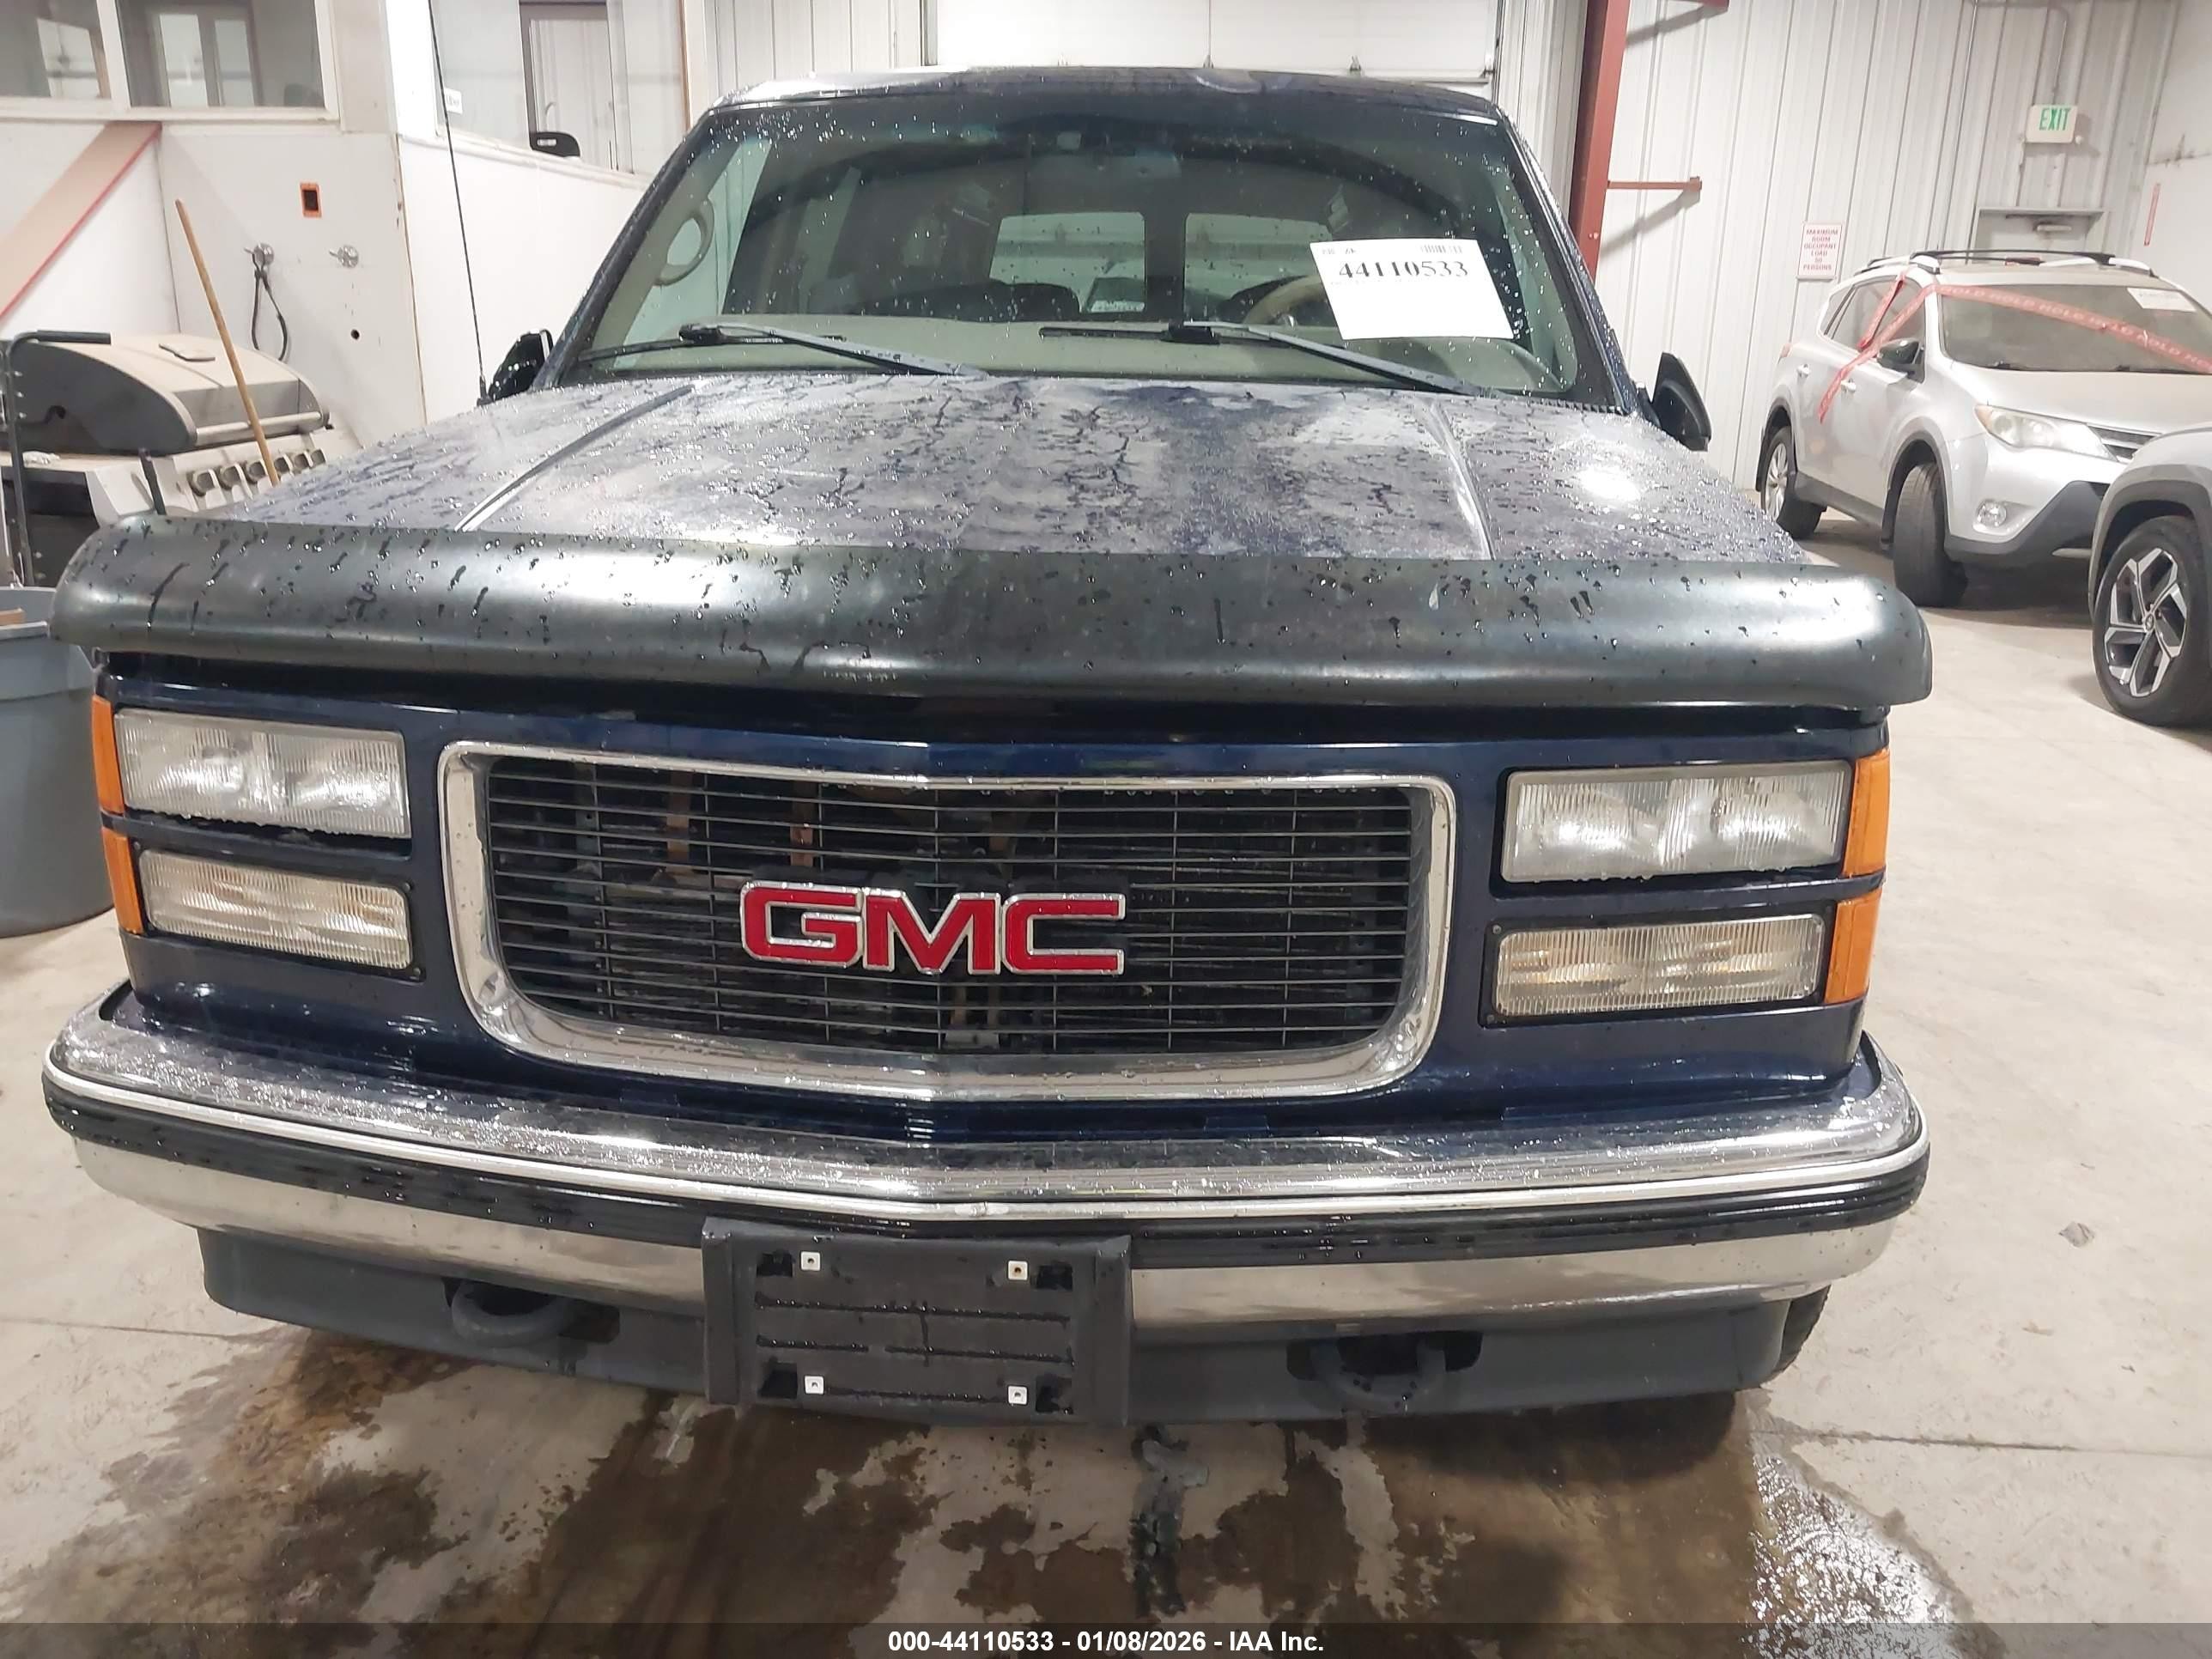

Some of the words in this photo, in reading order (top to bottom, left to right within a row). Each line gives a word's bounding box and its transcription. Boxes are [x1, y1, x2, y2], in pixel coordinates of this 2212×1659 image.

[2039, 107, 2071, 131] EXIT
[1339, 261, 1468, 277] 44110533
[739, 879, 1126, 975] GMC
